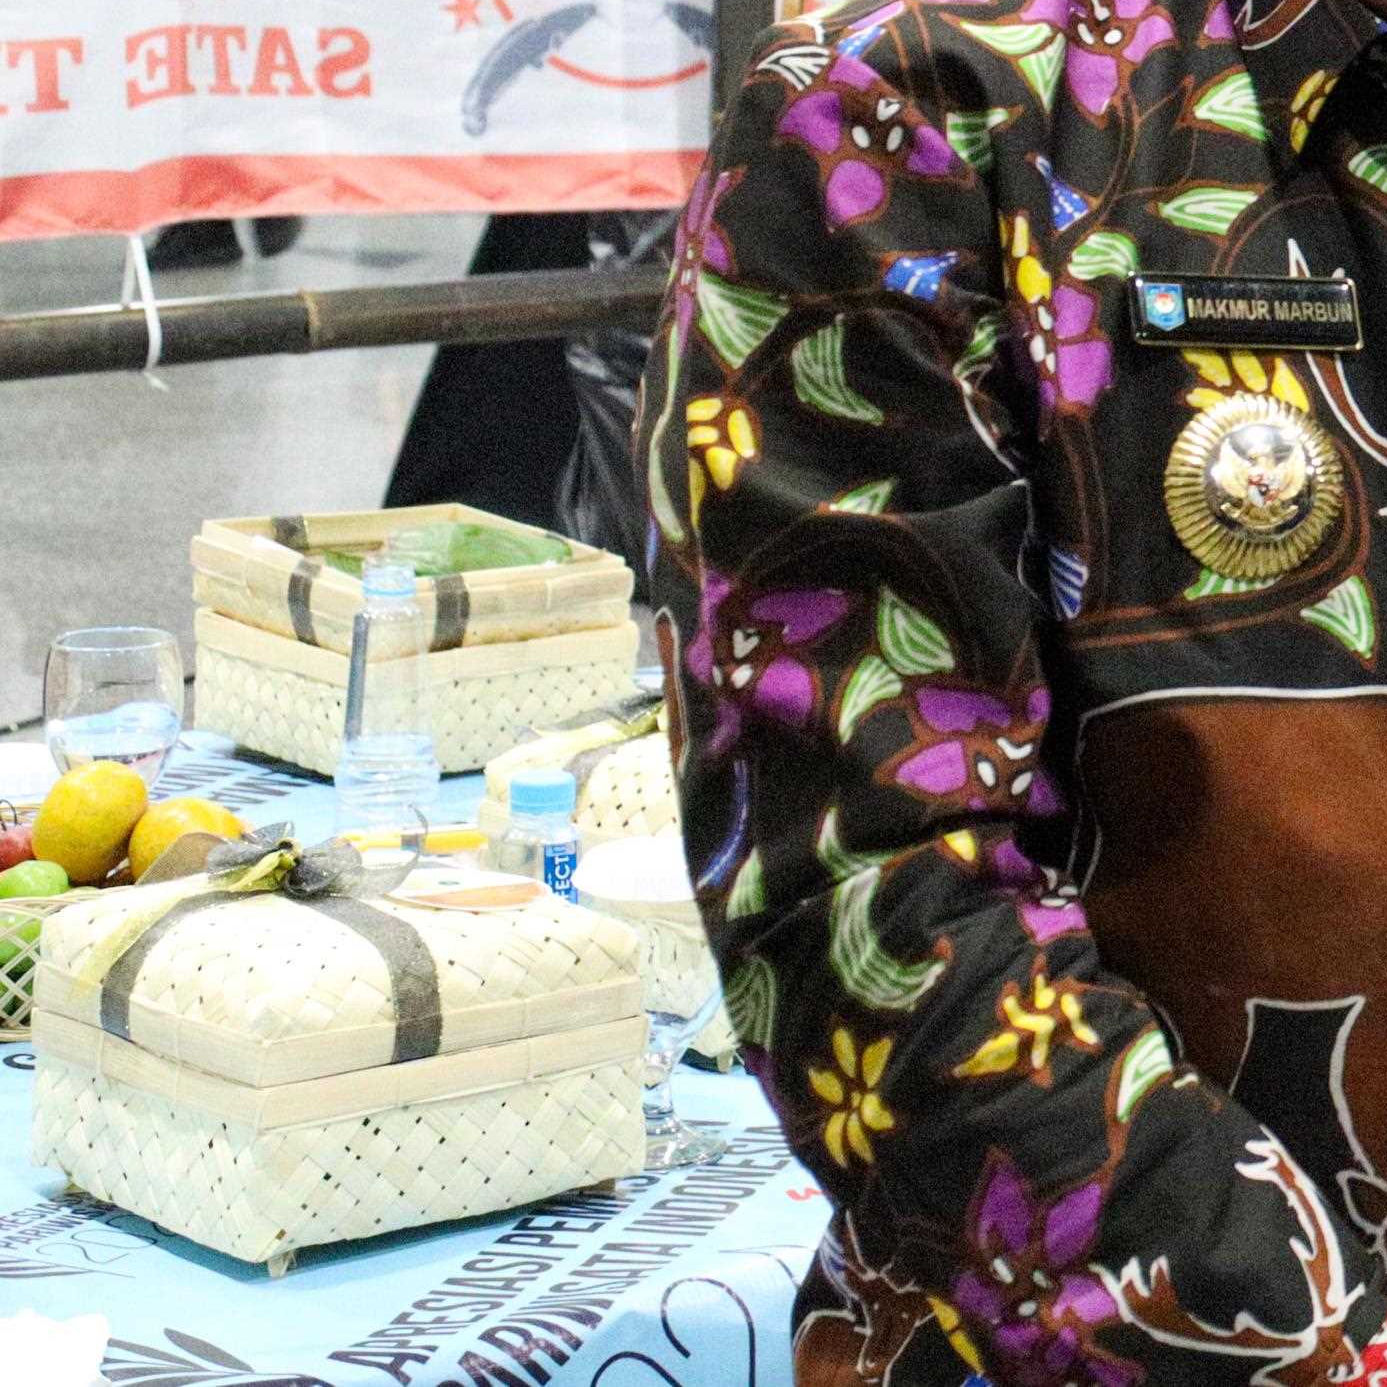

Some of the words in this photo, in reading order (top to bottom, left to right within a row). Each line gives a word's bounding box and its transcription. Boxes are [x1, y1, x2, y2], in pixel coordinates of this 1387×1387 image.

[1186, 297, 1272, 320] MAKMUR
[1274, 300, 1353, 323] MARBUN
[328, 1249, 565, 1386] APRESIASI
